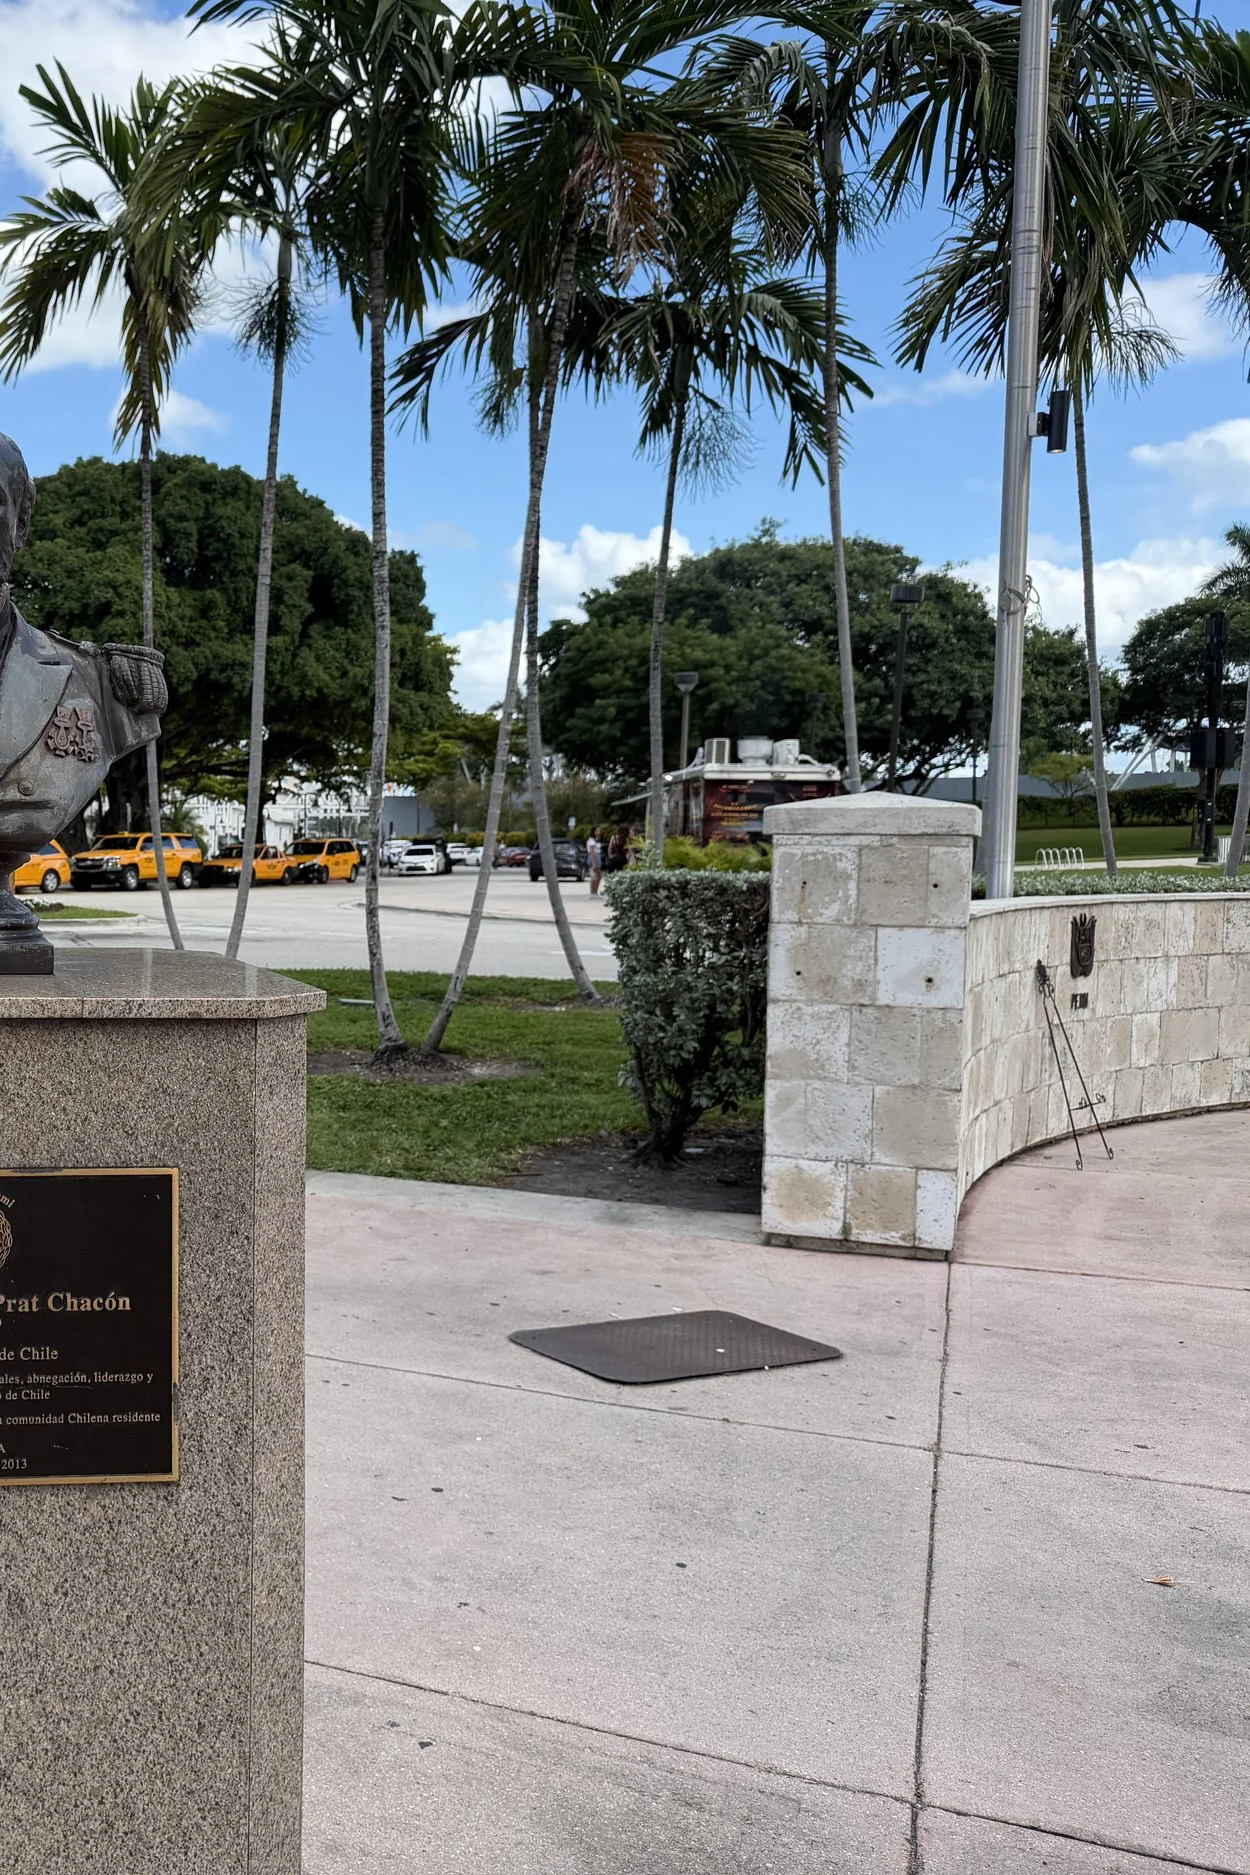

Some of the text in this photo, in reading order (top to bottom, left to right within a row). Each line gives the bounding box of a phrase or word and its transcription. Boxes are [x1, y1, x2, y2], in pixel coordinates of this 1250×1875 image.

[47, 1291, 131, 1312] Chacón
[19, 1346, 59, 1361] Chile
[93, 1371, 143, 1386] liderazgo
[145, 1373, 154, 1385] y
[5, 1390, 18, 1401] de
[21, 1389, 51, 1400] Chile
[5, 1414, 64, 1425] comunidad
[67, 1412, 109, 1424] Chilena
[112, 1411, 161, 1423] residente
[1, 1458, 28, 1470] 2013
